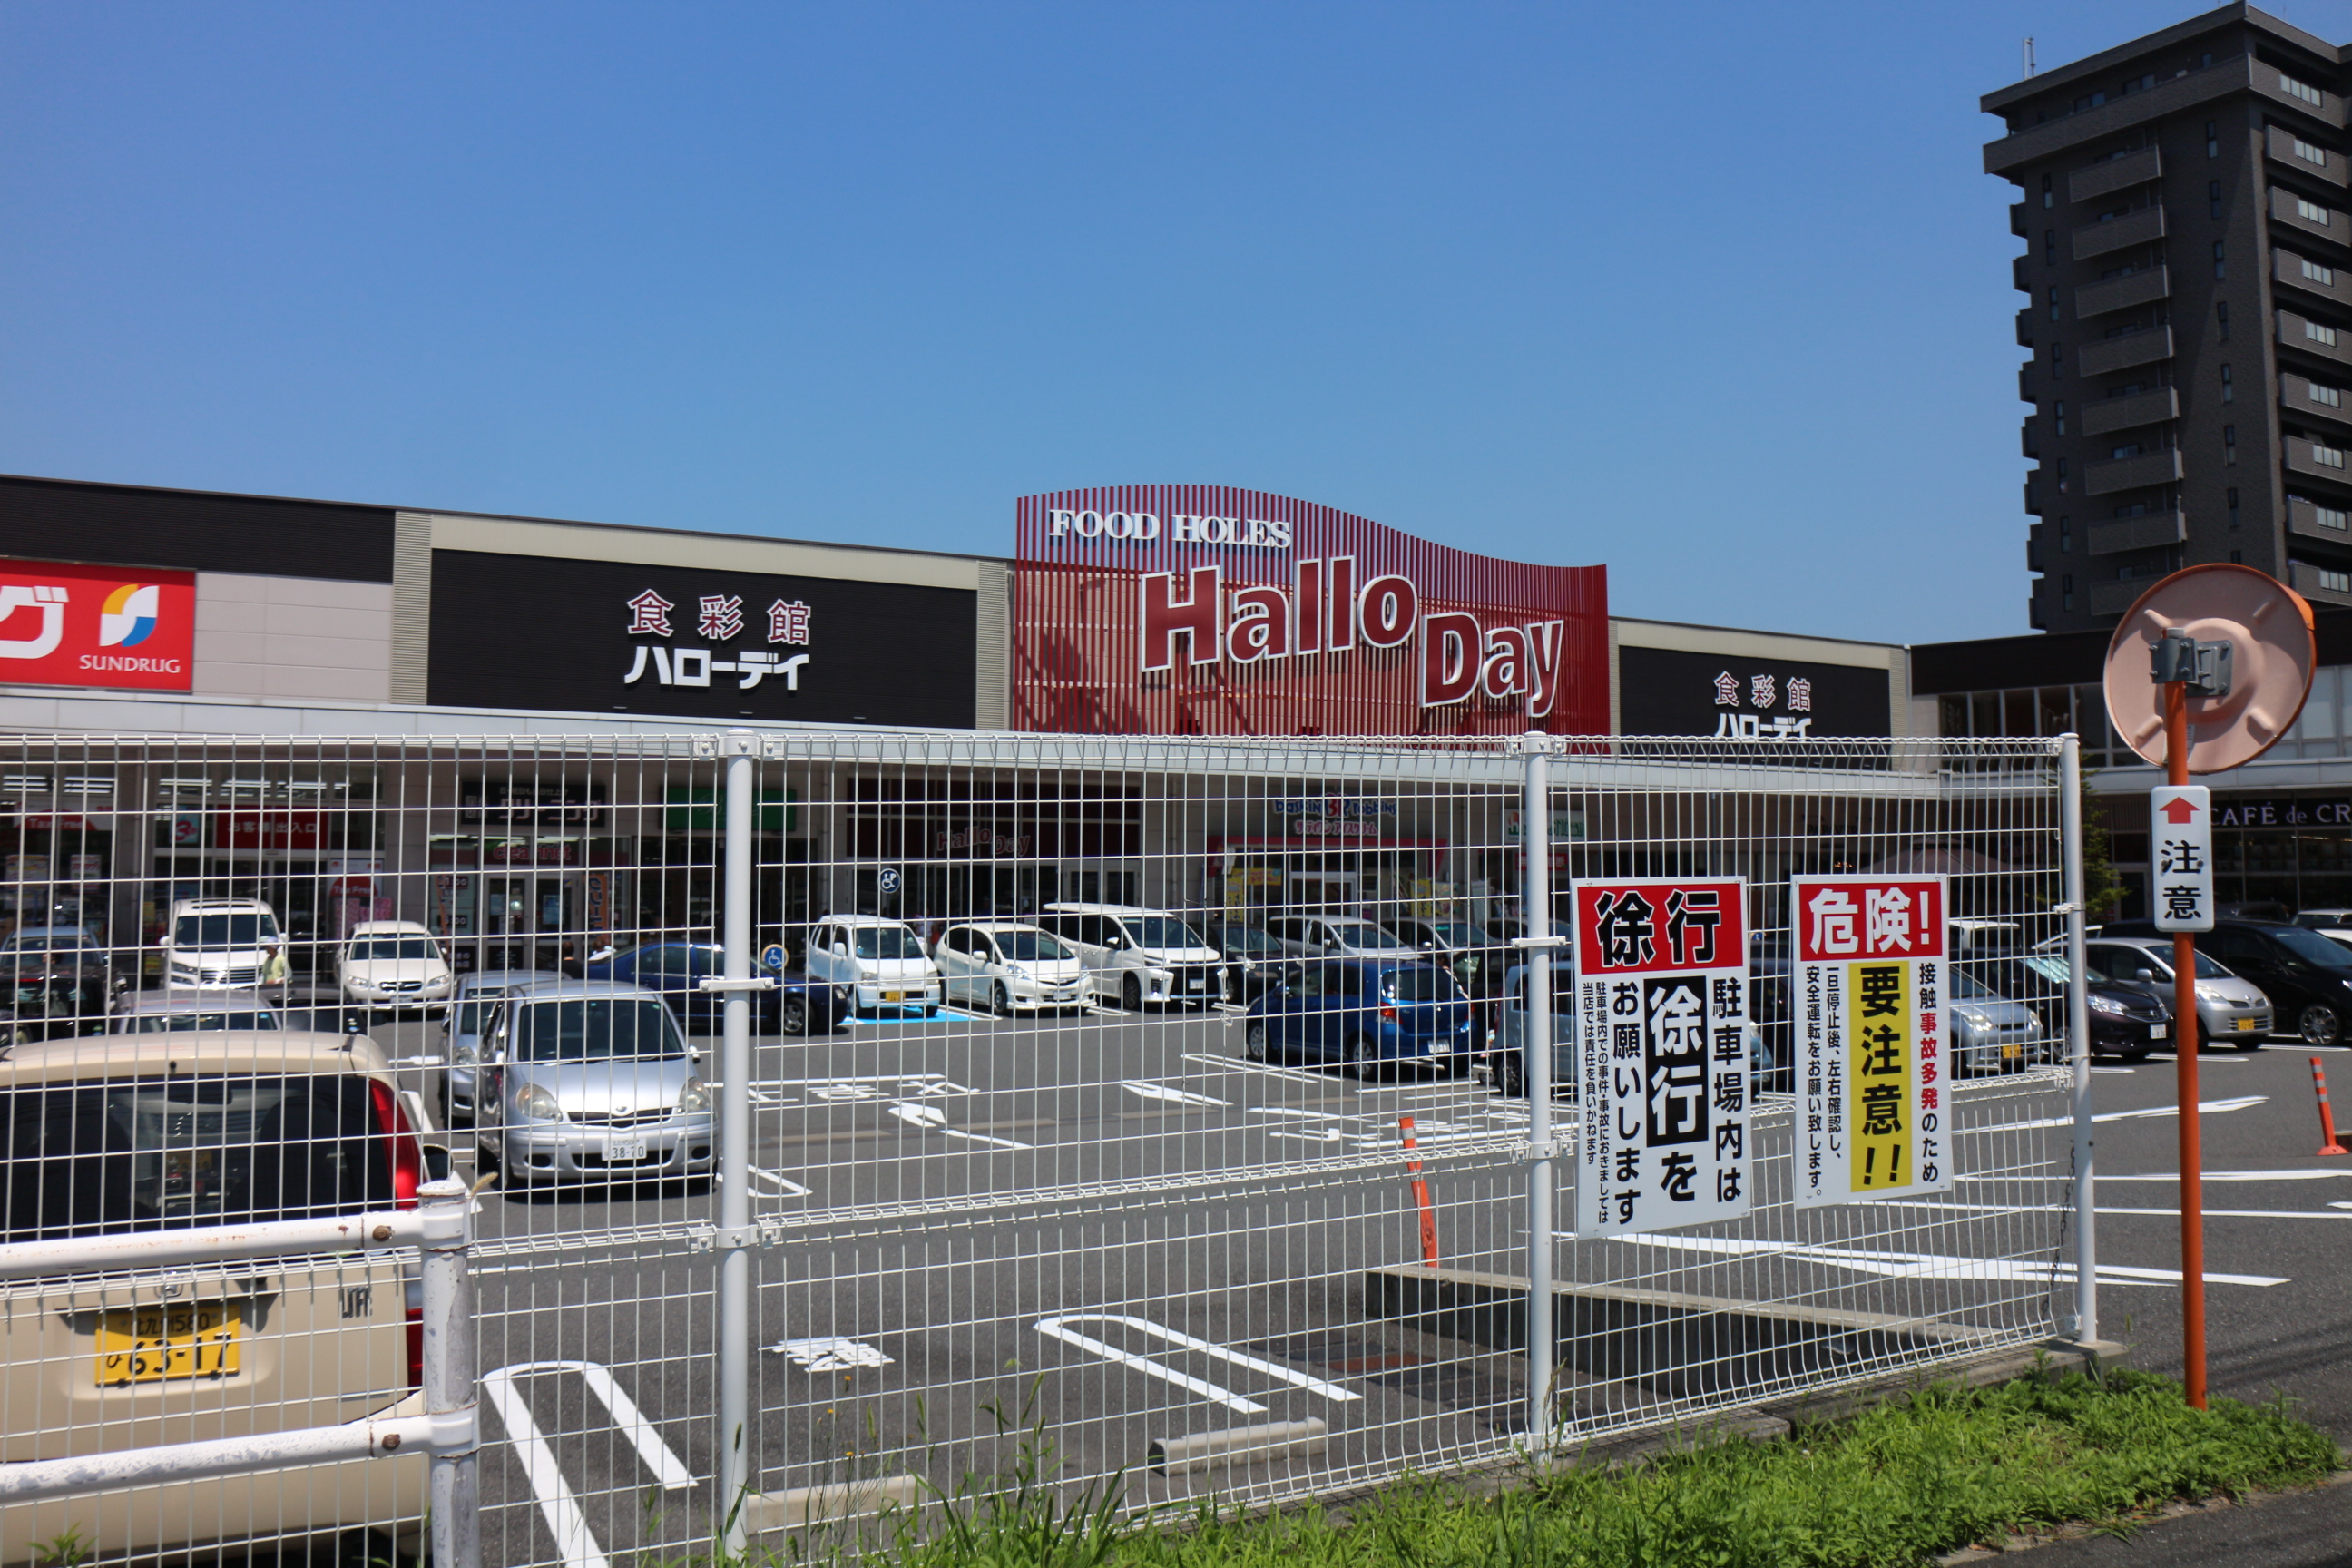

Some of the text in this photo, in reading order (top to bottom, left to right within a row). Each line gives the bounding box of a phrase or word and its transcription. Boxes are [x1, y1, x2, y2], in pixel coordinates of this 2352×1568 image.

[1049, 509, 1291, 549] FOOD HOLES
[626, 587, 811, 646] 食彩館
[1141, 554, 1418, 672] Hallo
[79, 653, 181, 674] SUNDRUG
[1418, 611, 1564, 719] Day
[1713, 671, 1812, 712] 食彩館
[936, 826, 1031, 857] Hallo Day
[2286, 805, 2308, 824] de
[2161, 839, 2202, 919] 注意
[1594, 888, 1720, 968] 徐行
[1808, 887, 1931, 956] 危険!
[1582, 982, 1597, 1166] 当店では責任を負いかねます
[1595, 981, 1610, 1225] 駐車場内での事件・事故におきましては
[1712, 976, 1744, 1203] 駐車場内は
[1806, 965, 1822, 1196] 安全運転をお願い致します。
[1826, 966, 1842, 1160] 一旦停止後、左右確認し、
[1918, 962, 1939, 1183] 接触事故多発のため
[1612, 981, 1642, 1226] お願いします
[128, 1332, 232, 1376] 63-17
